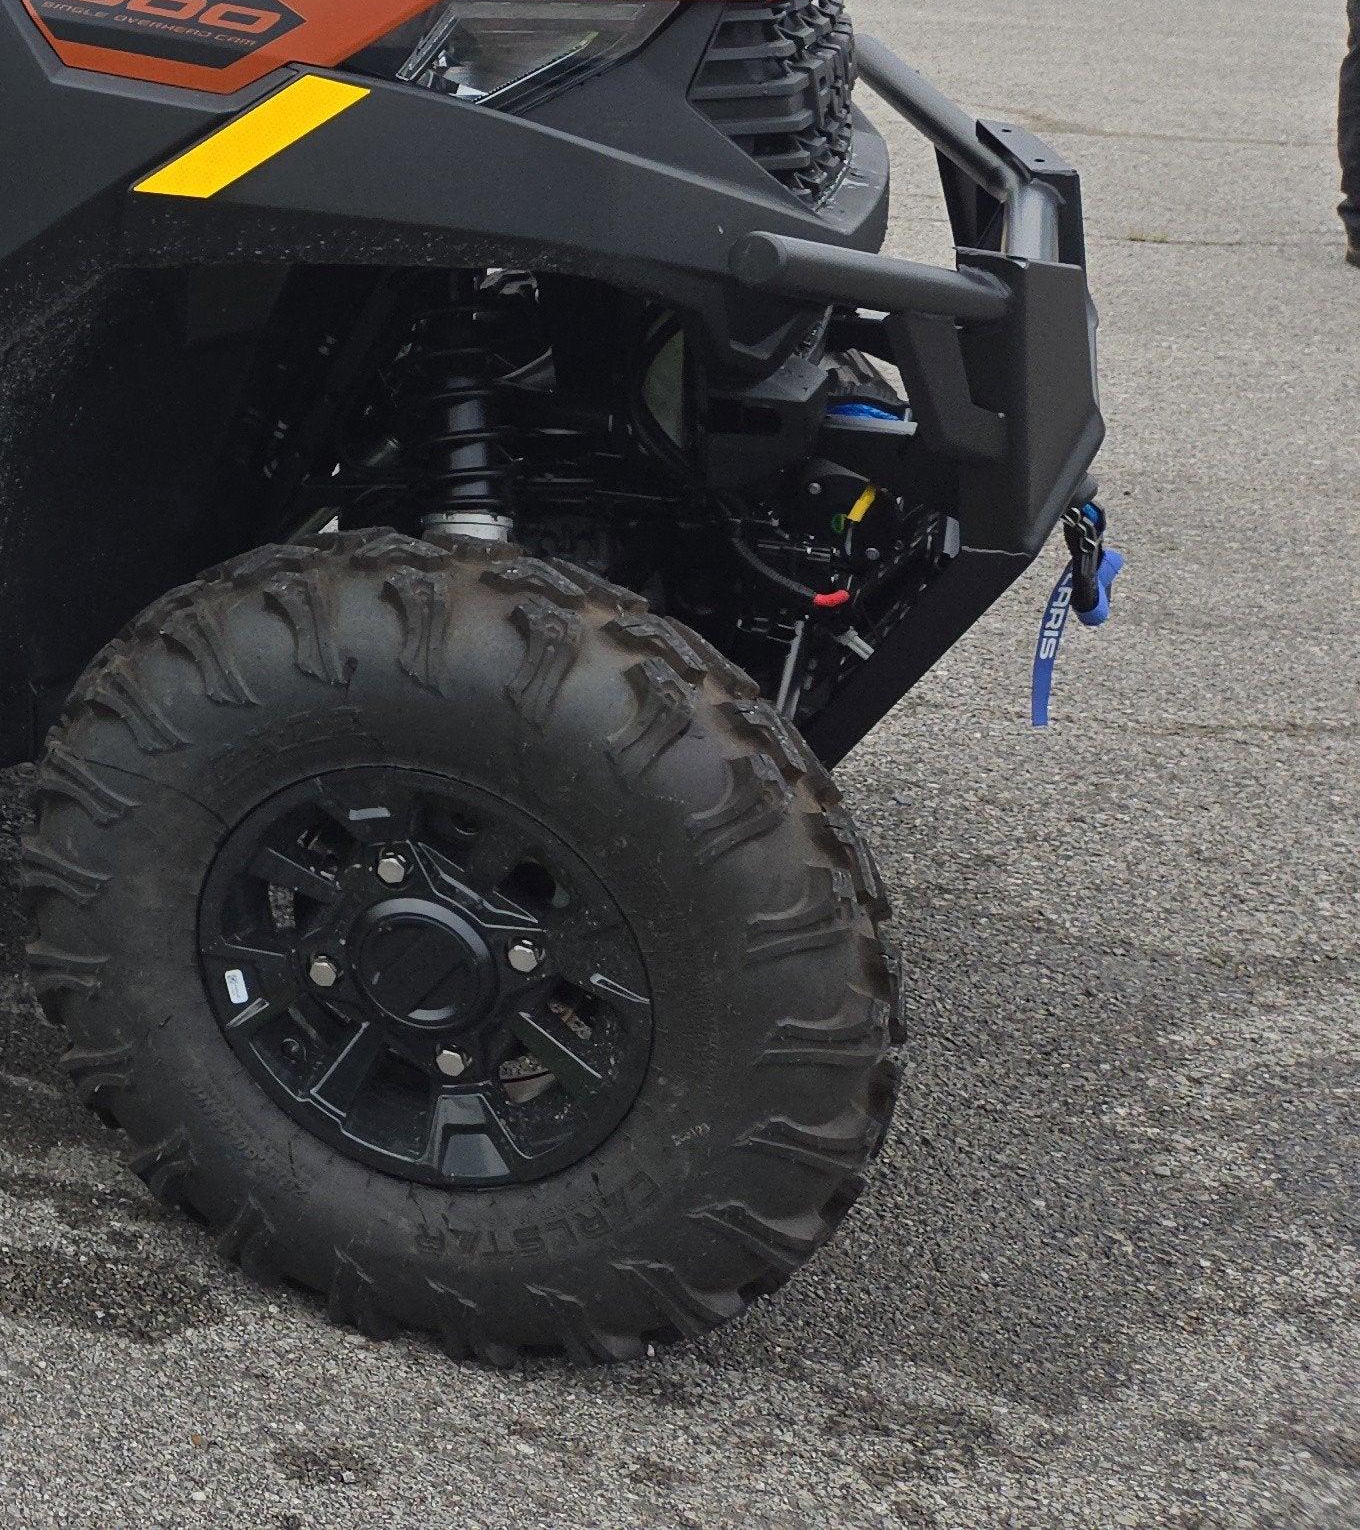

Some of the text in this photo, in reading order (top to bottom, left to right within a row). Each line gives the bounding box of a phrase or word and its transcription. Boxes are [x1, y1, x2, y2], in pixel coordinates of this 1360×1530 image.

[41, 1, 257, 47] SINGLE OVERHEAD CAM
